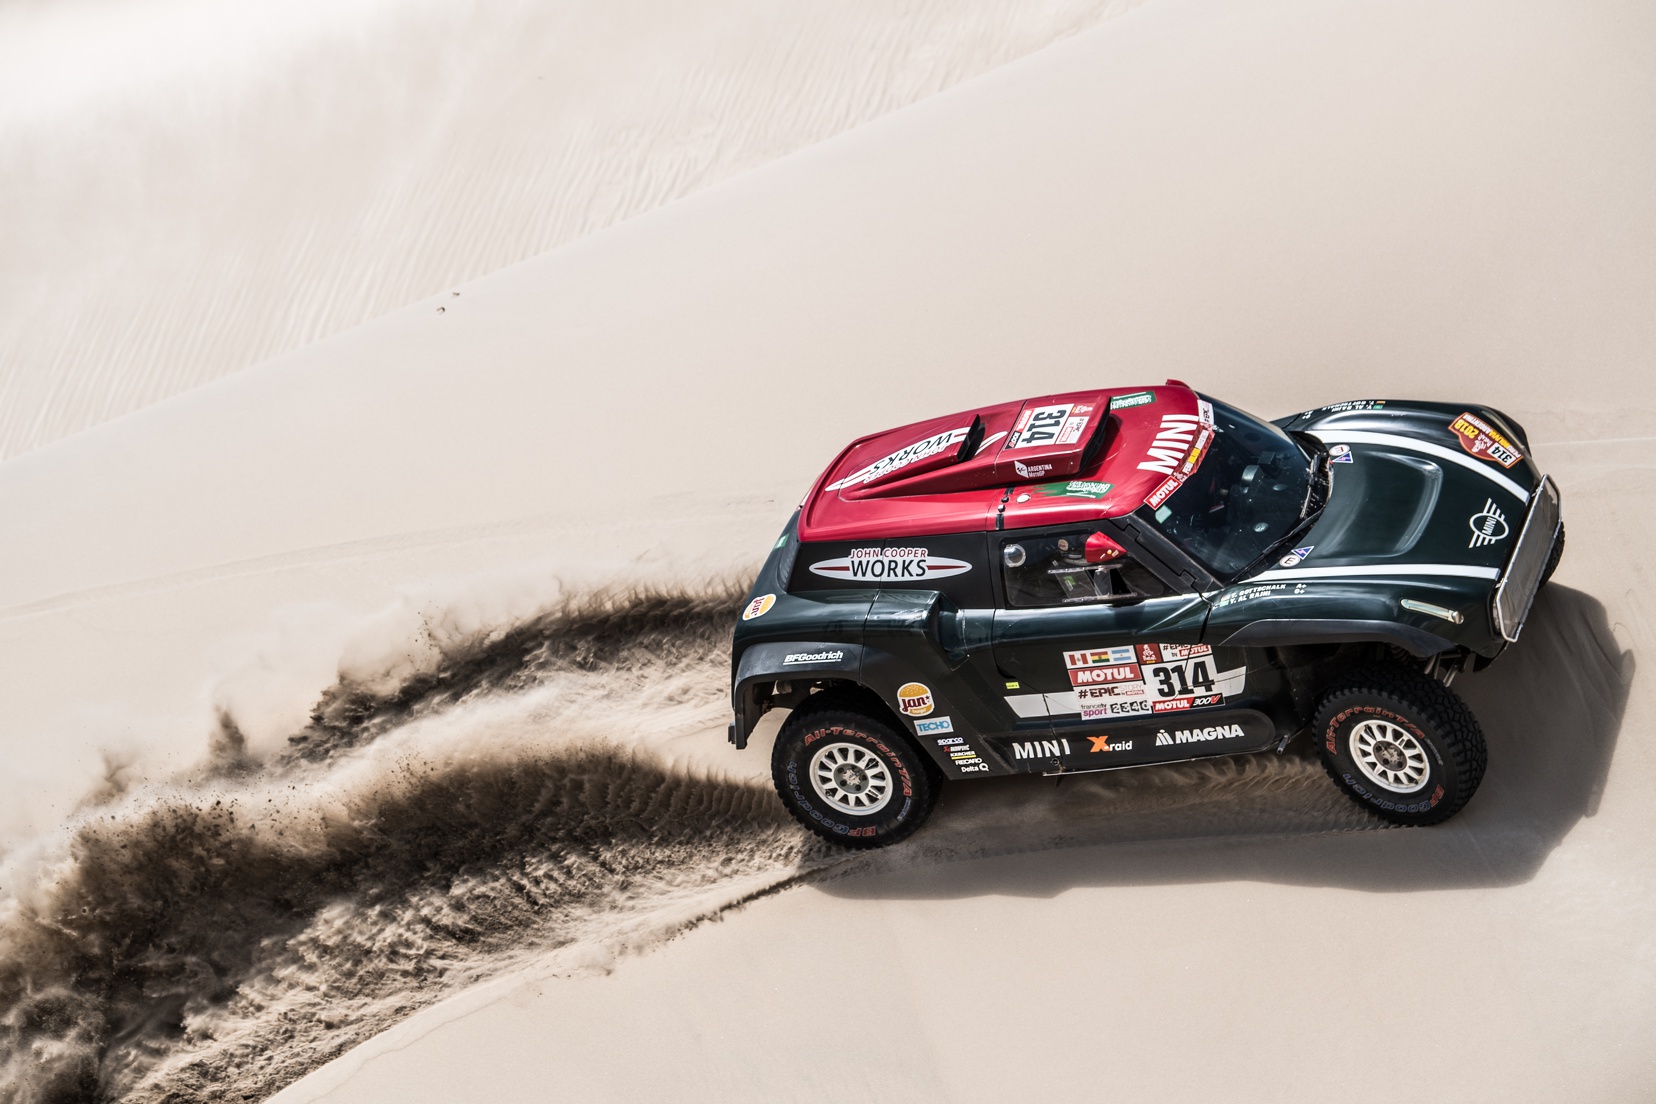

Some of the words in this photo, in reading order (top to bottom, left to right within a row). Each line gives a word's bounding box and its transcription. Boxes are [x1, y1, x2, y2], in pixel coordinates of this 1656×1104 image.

[1021, 409, 1067, 444] 314
[1454, 419, 1479, 439] 2018
[869, 432, 953, 476] WORKS
[1136, 414, 1200, 475] MINI
[1491, 446, 1512, 463] 314
[1027, 464, 1053, 473] ARGENTINA
[1150, 479, 1179, 507] MOTUL
[1482, 516, 1497, 536] MINI
[850, 548, 880, 559] JOHN
[883, 548, 927, 558] COOPER
[851, 559, 927, 578] WORKS
[784, 650, 843, 664] BFGoodrich
[1180, 646, 1209, 656] MOTUL
[1077, 667, 1135, 683] MOTUL
[1153, 661, 1215, 698] 314
[1155, 700, 1190, 711] MOTUL
[1193, 694, 1221, 706] 300V
[1083, 707, 1108, 718] sport
[917, 720, 950, 732] TECHO
[1175, 724, 1245, 744] MAGNA
[1012, 738, 1071, 759] MINI
